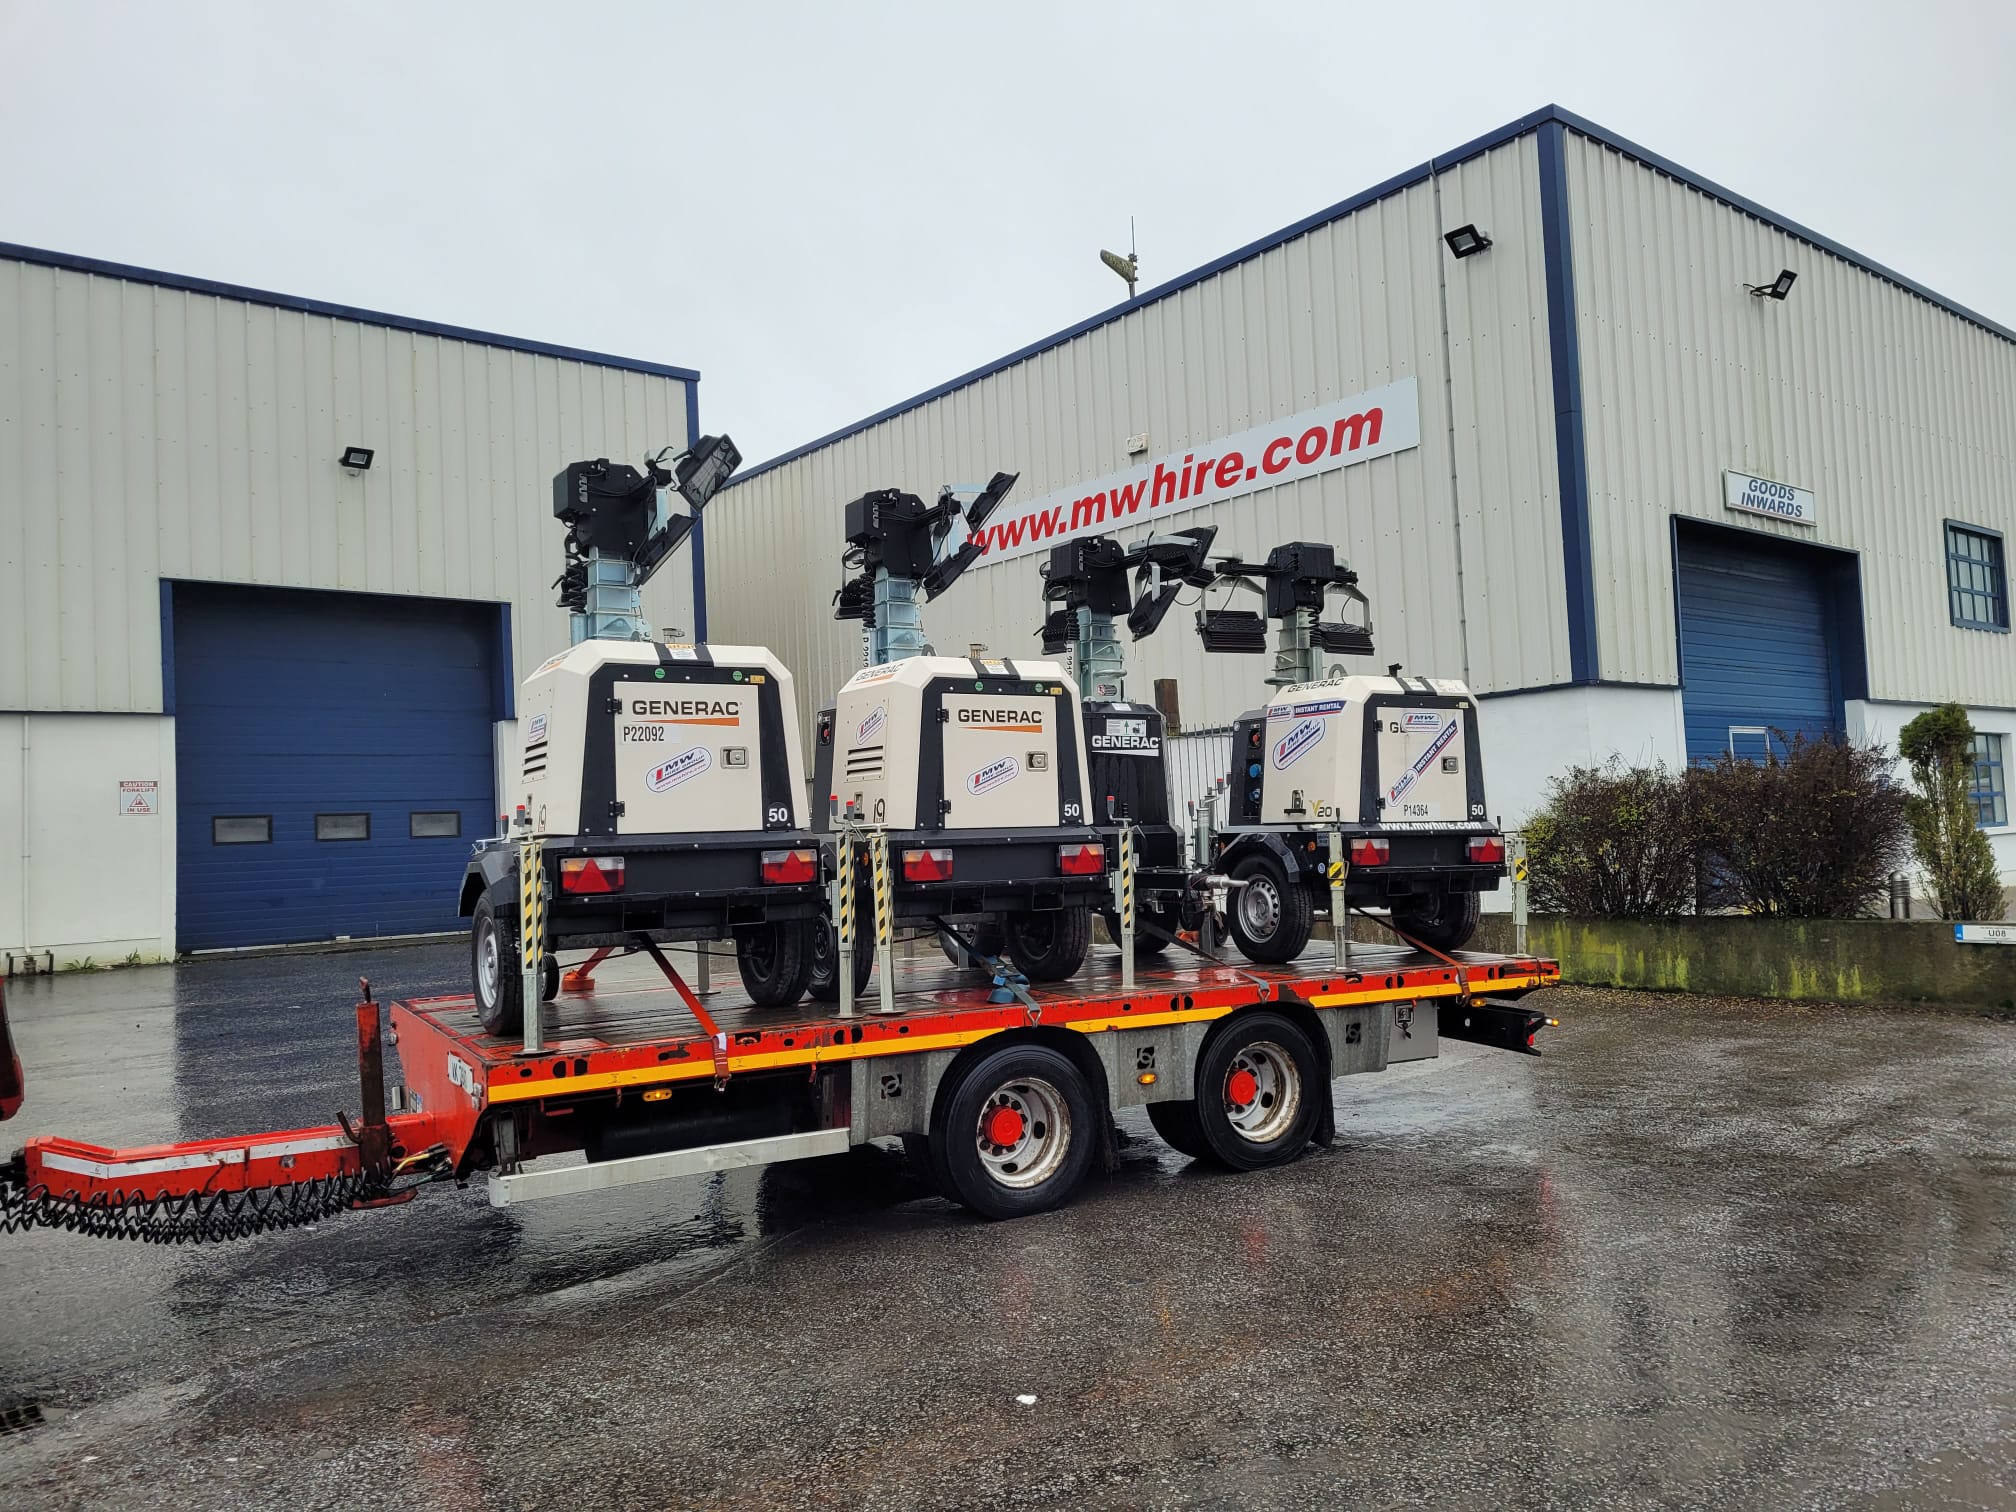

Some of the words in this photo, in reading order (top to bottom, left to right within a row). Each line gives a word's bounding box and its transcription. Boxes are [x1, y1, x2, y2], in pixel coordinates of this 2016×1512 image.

[967, 407, 1383, 555] www.mwhire.com
[1748, 479, 1795, 501] GOODS
[1741, 491, 1803, 518] INWARDS
[1288, 678, 1344, 693] GENERAC
[632, 700, 739, 716] GENERAC
[958, 709, 1042, 723] GENERAC
[1295, 705, 1319, 714] INSTANT
[1319, 702, 1341, 711] RENTAL
[623, 725, 665, 742] P22092
[1287, 720, 1312, 746] MW
[1092, 736, 1159, 748] GENERAC
[1416, 745, 1438, 771] INSTANT
[1435, 725, 1457, 748] RENTAL
[665, 752, 695, 772] MW
[982, 761, 1006, 777] MW
[768, 808, 788, 822] 50
[1064, 803, 1080, 817] 50
[1308, 800, 1332, 817] V20
[1403, 804, 1429, 816] P14364
[1471, 804, 1484, 815] 50
[1379, 821, 1482, 831] www.mwhire.com
